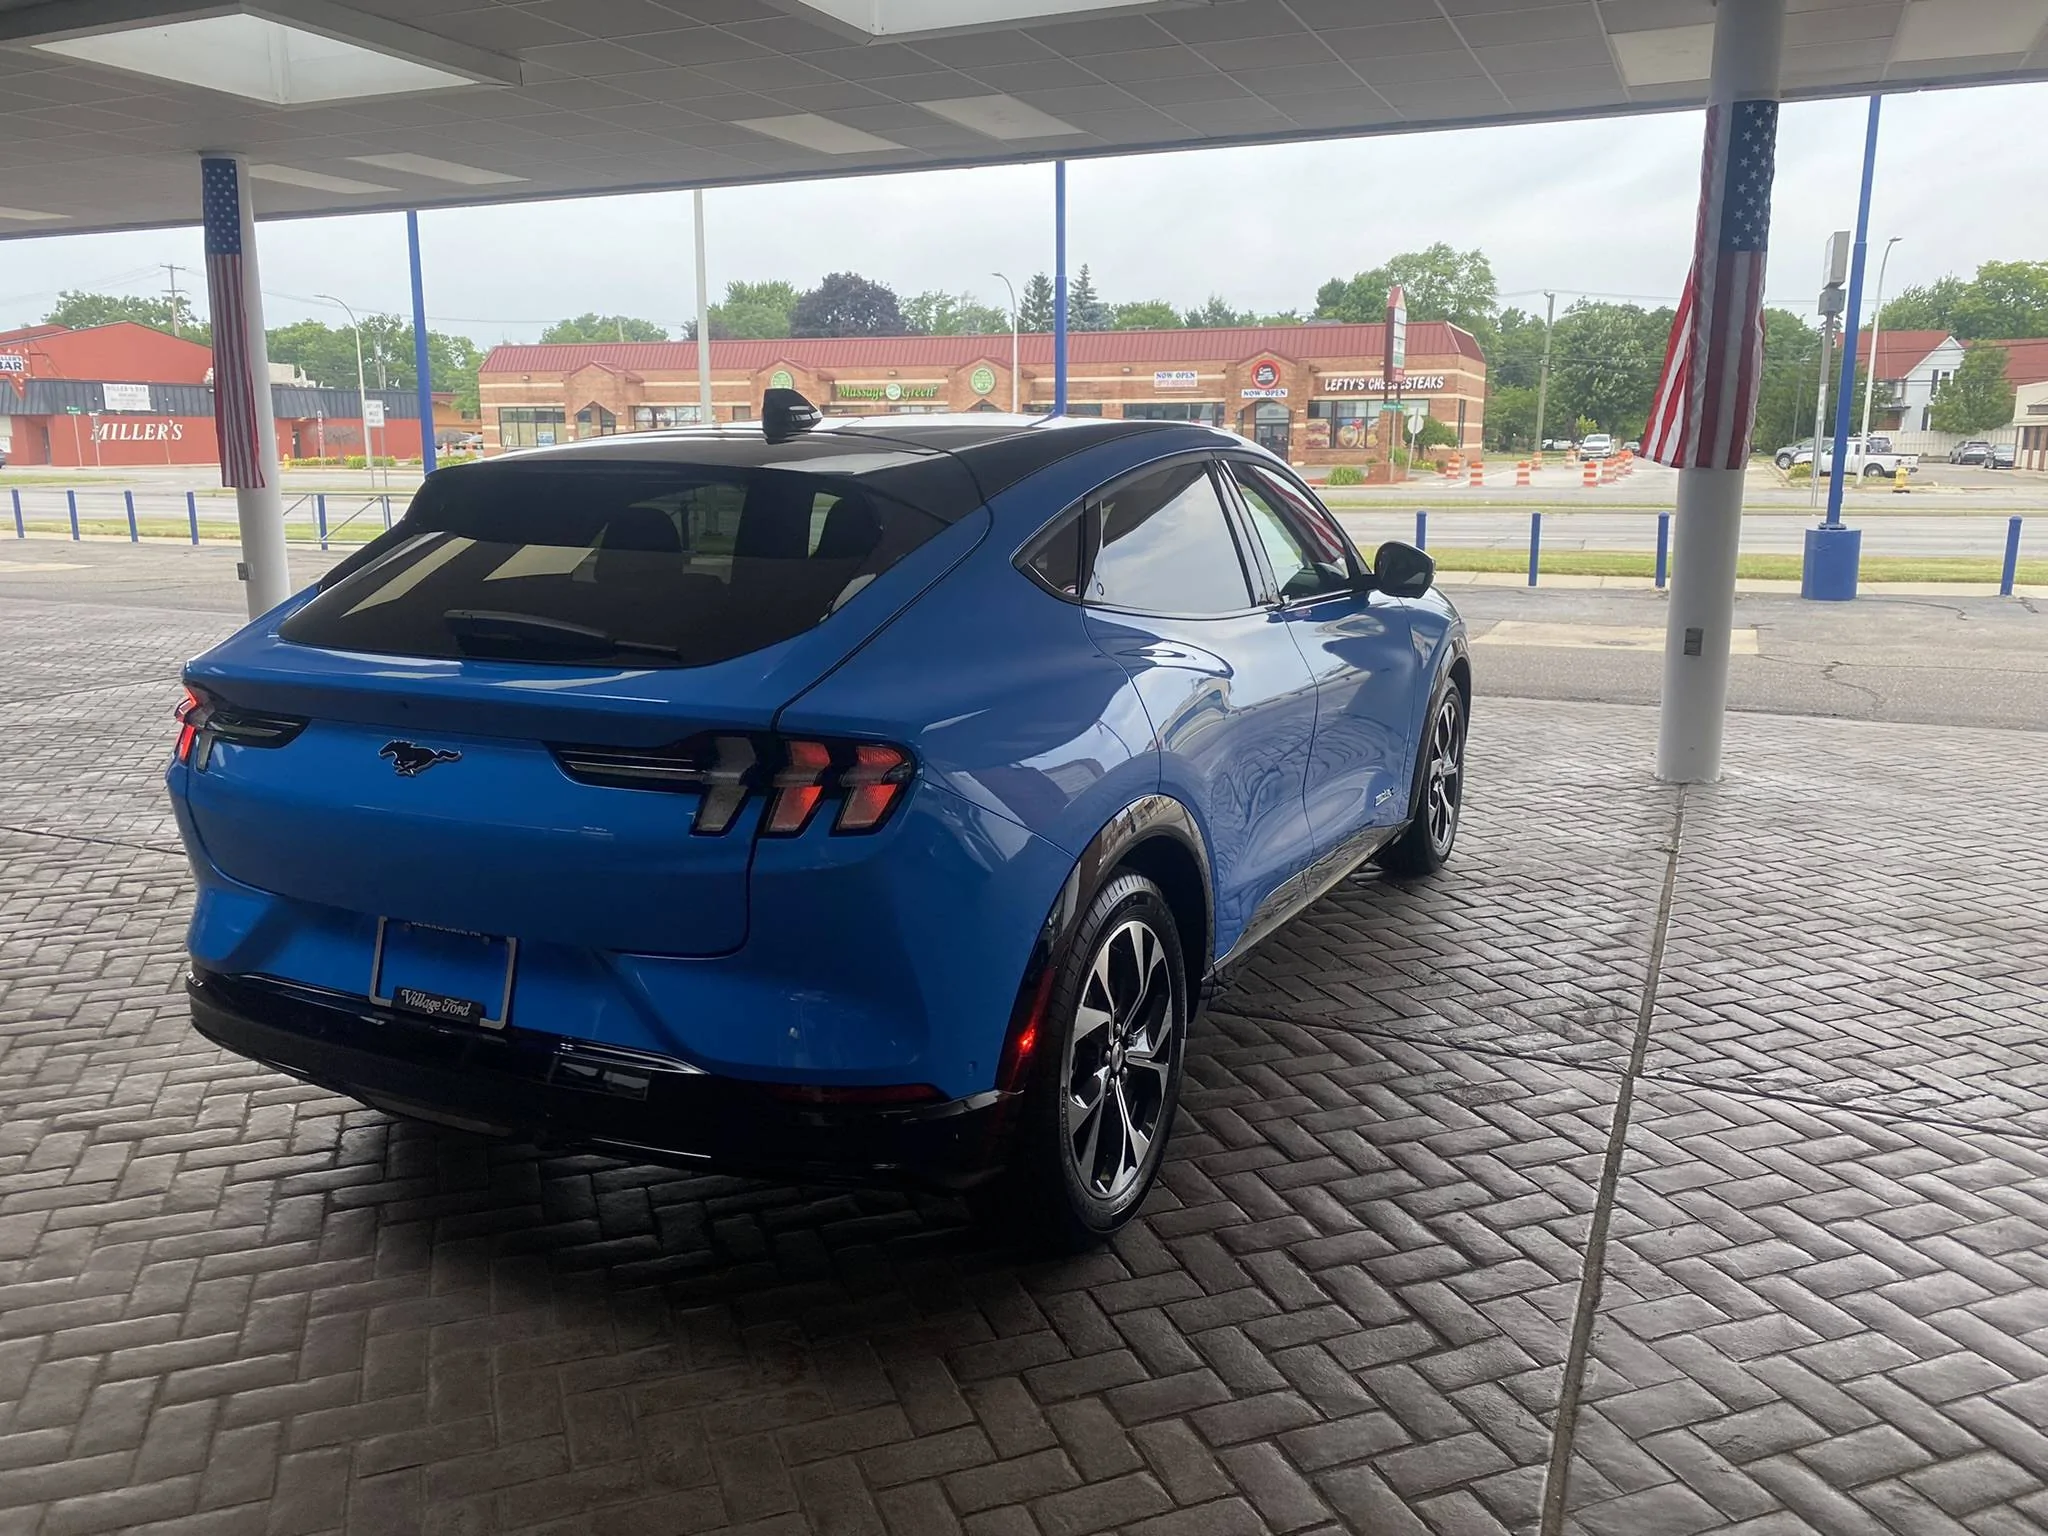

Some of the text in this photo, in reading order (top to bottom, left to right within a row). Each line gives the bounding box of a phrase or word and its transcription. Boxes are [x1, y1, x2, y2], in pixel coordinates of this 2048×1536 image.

[1175, 371, 1195, 379] OPEN
[1324, 378, 1365, 391] LEFTY'S
[901, 385, 935, 401] Green
[91, 419, 183, 440] MILLER'S
[401, 989, 472, 1017] Village Ford
